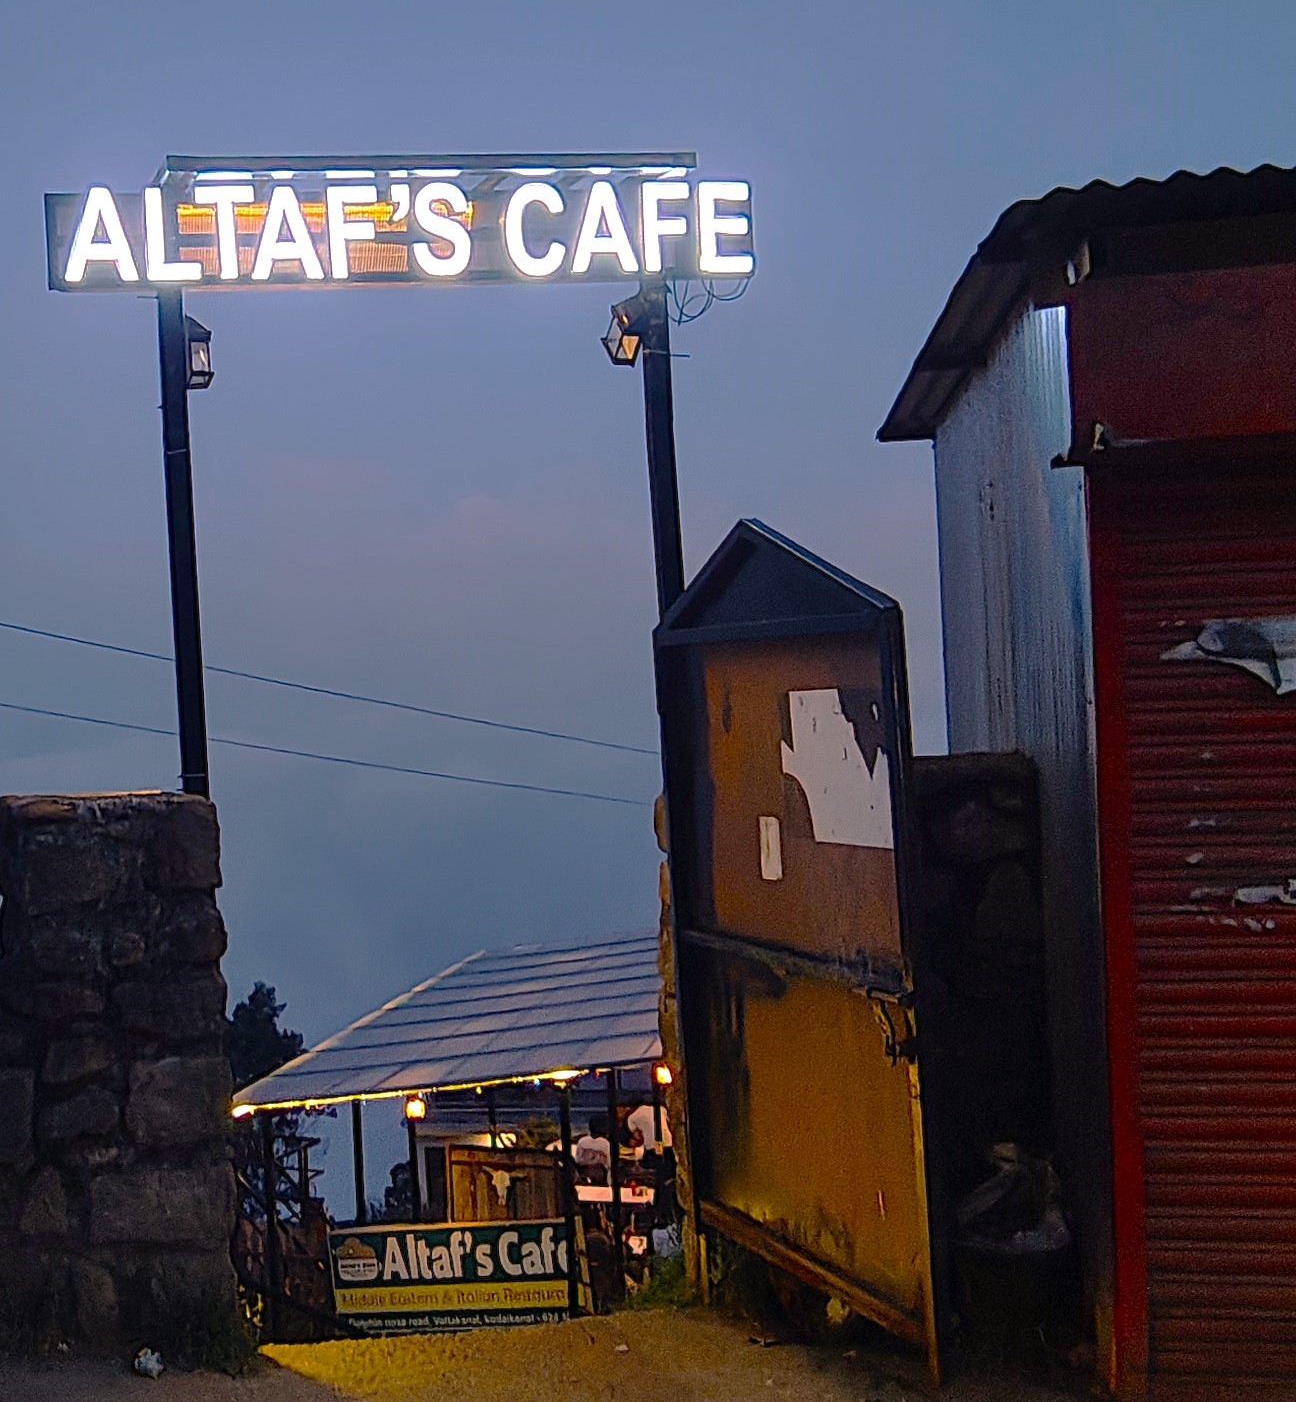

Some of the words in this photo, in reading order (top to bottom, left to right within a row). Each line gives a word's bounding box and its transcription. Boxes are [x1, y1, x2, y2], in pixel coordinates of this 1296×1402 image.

[63, 181, 473, 284] ALTAF'S
[503, 179, 755, 278] CAFE
[382, 1229, 495, 1281] Altaf's
